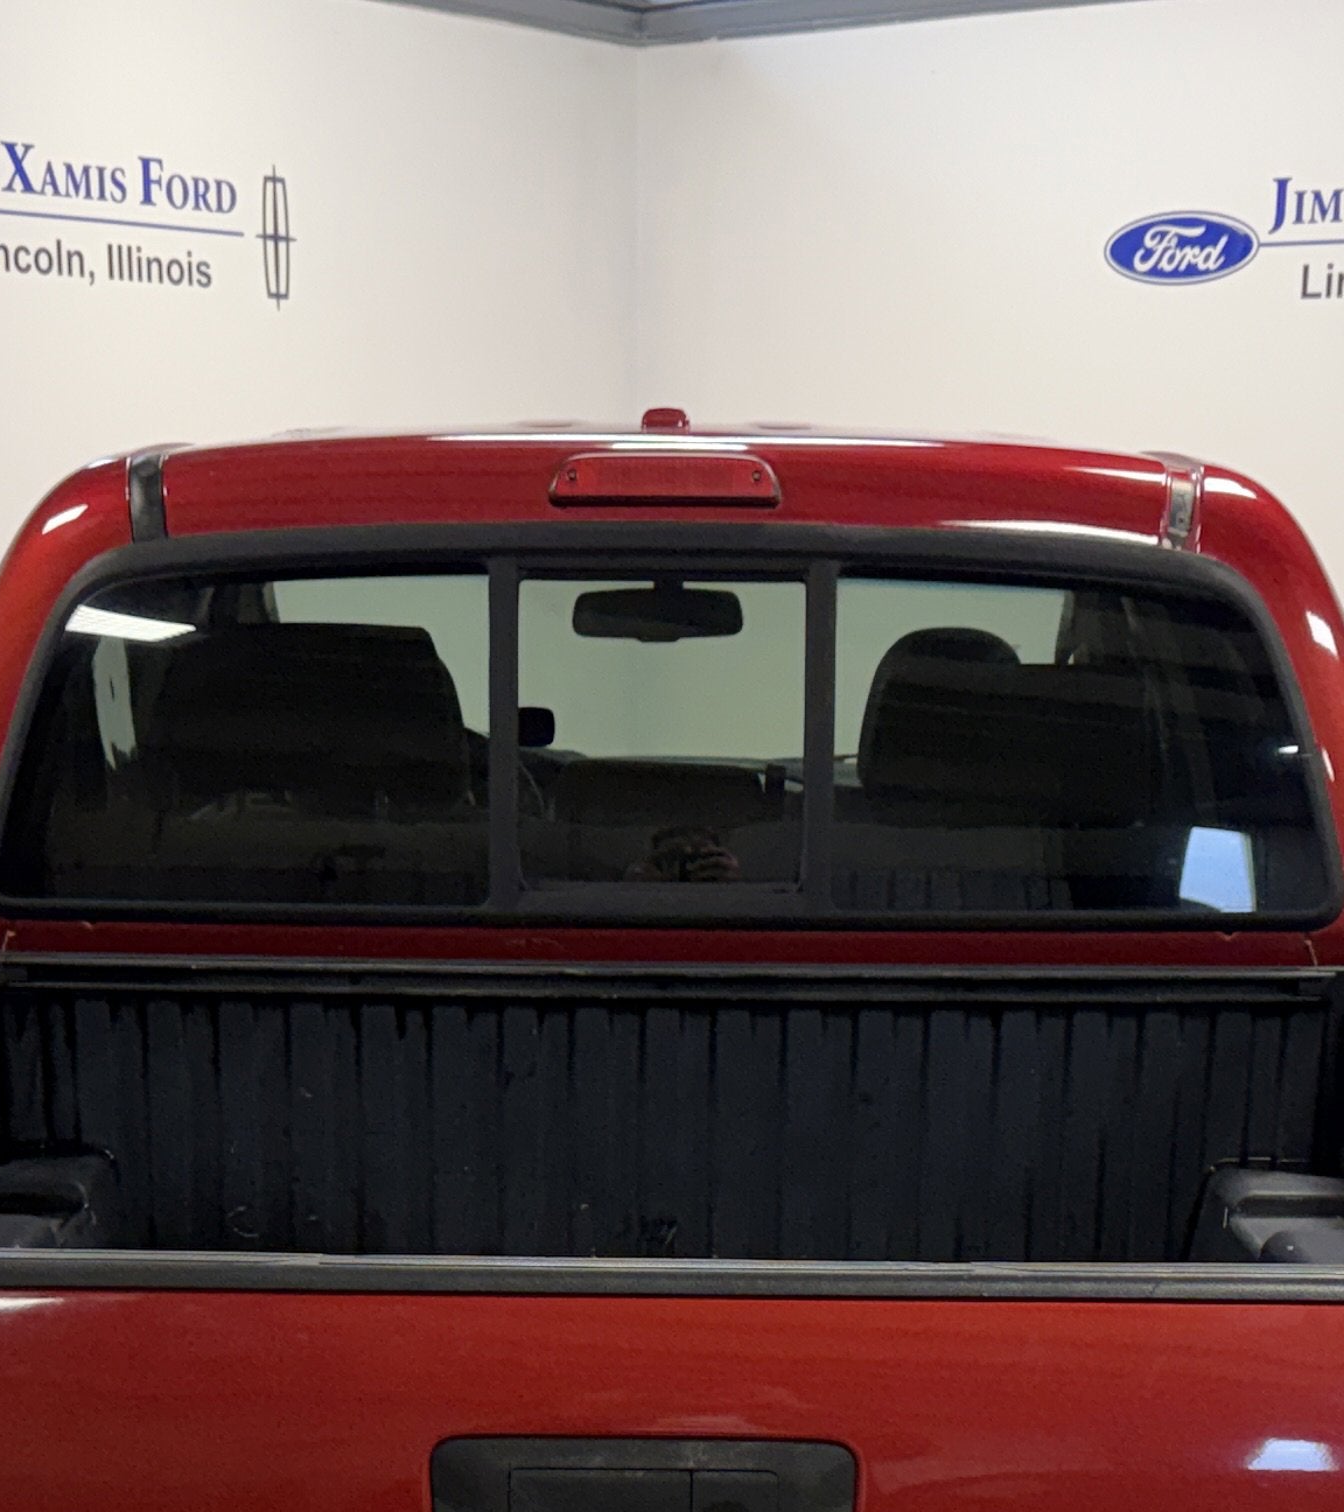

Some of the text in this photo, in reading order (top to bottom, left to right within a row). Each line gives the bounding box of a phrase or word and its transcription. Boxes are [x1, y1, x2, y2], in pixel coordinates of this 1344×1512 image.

[0, 140, 127, 203] XAMIS
[138, 156, 237, 214] FORD
[1268, 176, 1344, 234] JIM
[107, 243, 212, 288] Illinois
[1133, 224, 1226, 273] Ford
